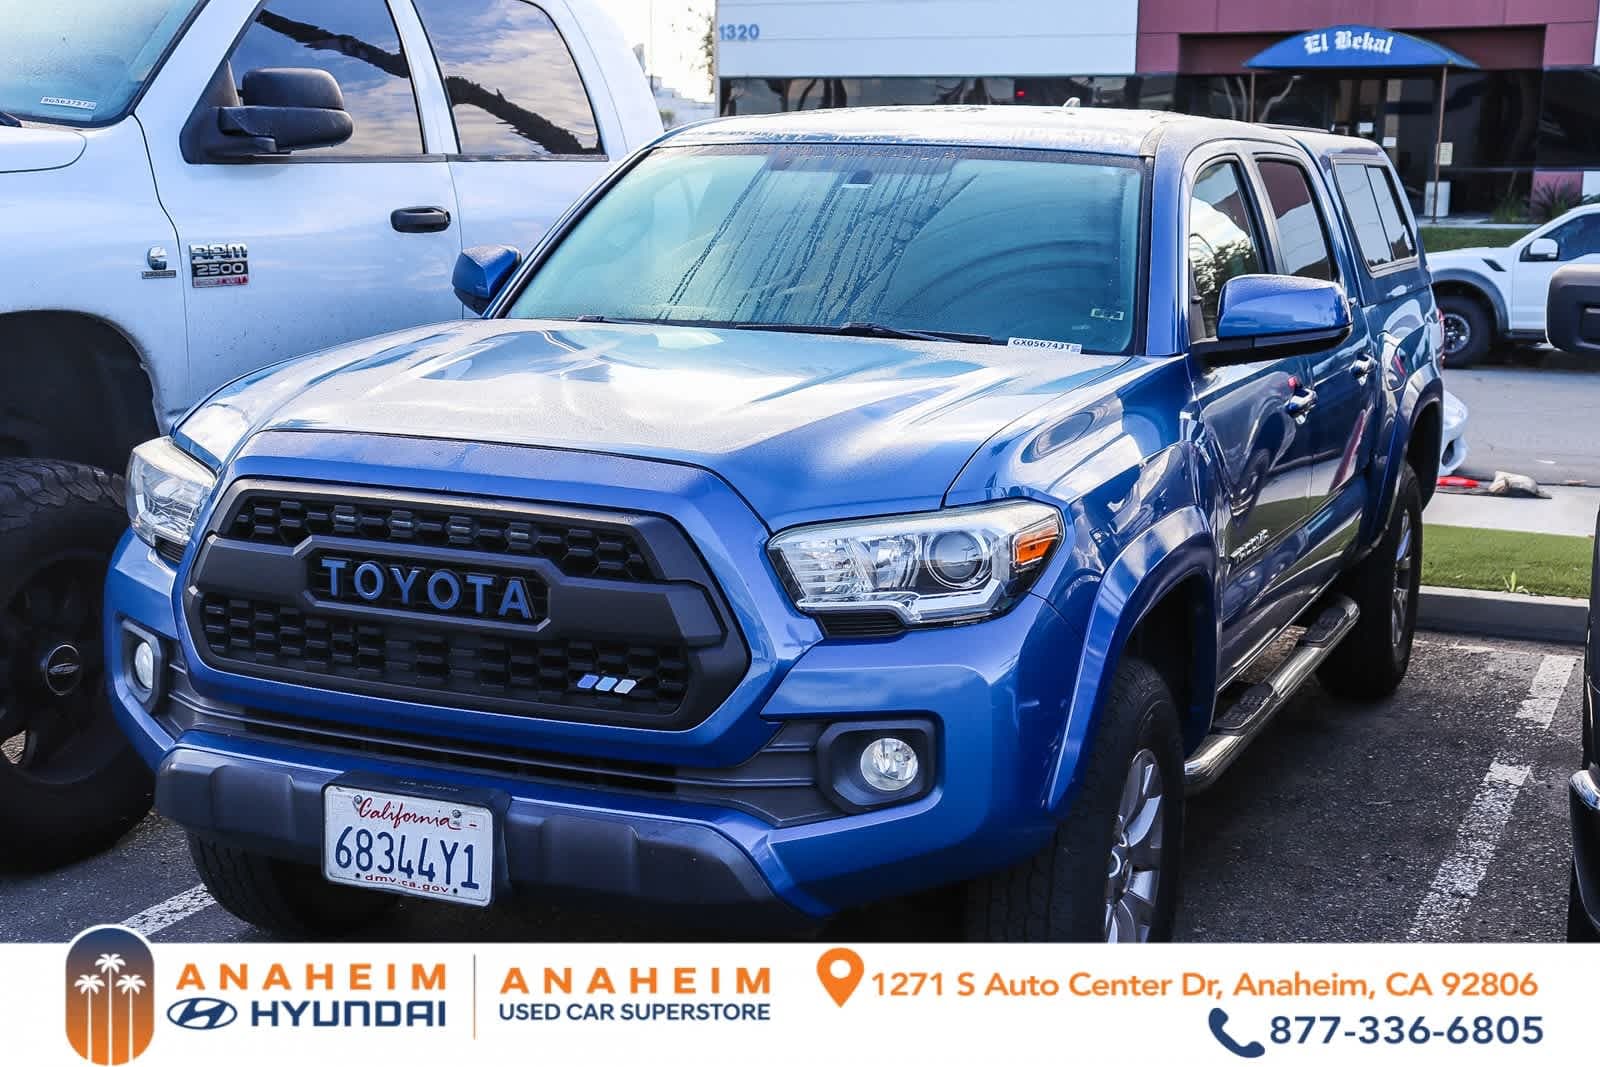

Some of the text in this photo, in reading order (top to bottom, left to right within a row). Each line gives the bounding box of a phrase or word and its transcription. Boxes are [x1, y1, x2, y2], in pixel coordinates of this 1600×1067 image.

[719, 23, 760, 41] 1320
[1303, 32, 1329, 56] El
[196, 262, 245, 276] 2500
[1012, 338, 1072, 351] GX056743T
[320, 557, 536, 619] TOYOTA
[358, 797, 462, 831] California
[335, 825, 480, 890] 68344Y1
[364, 873, 450, 894] dmv.ca.gov
